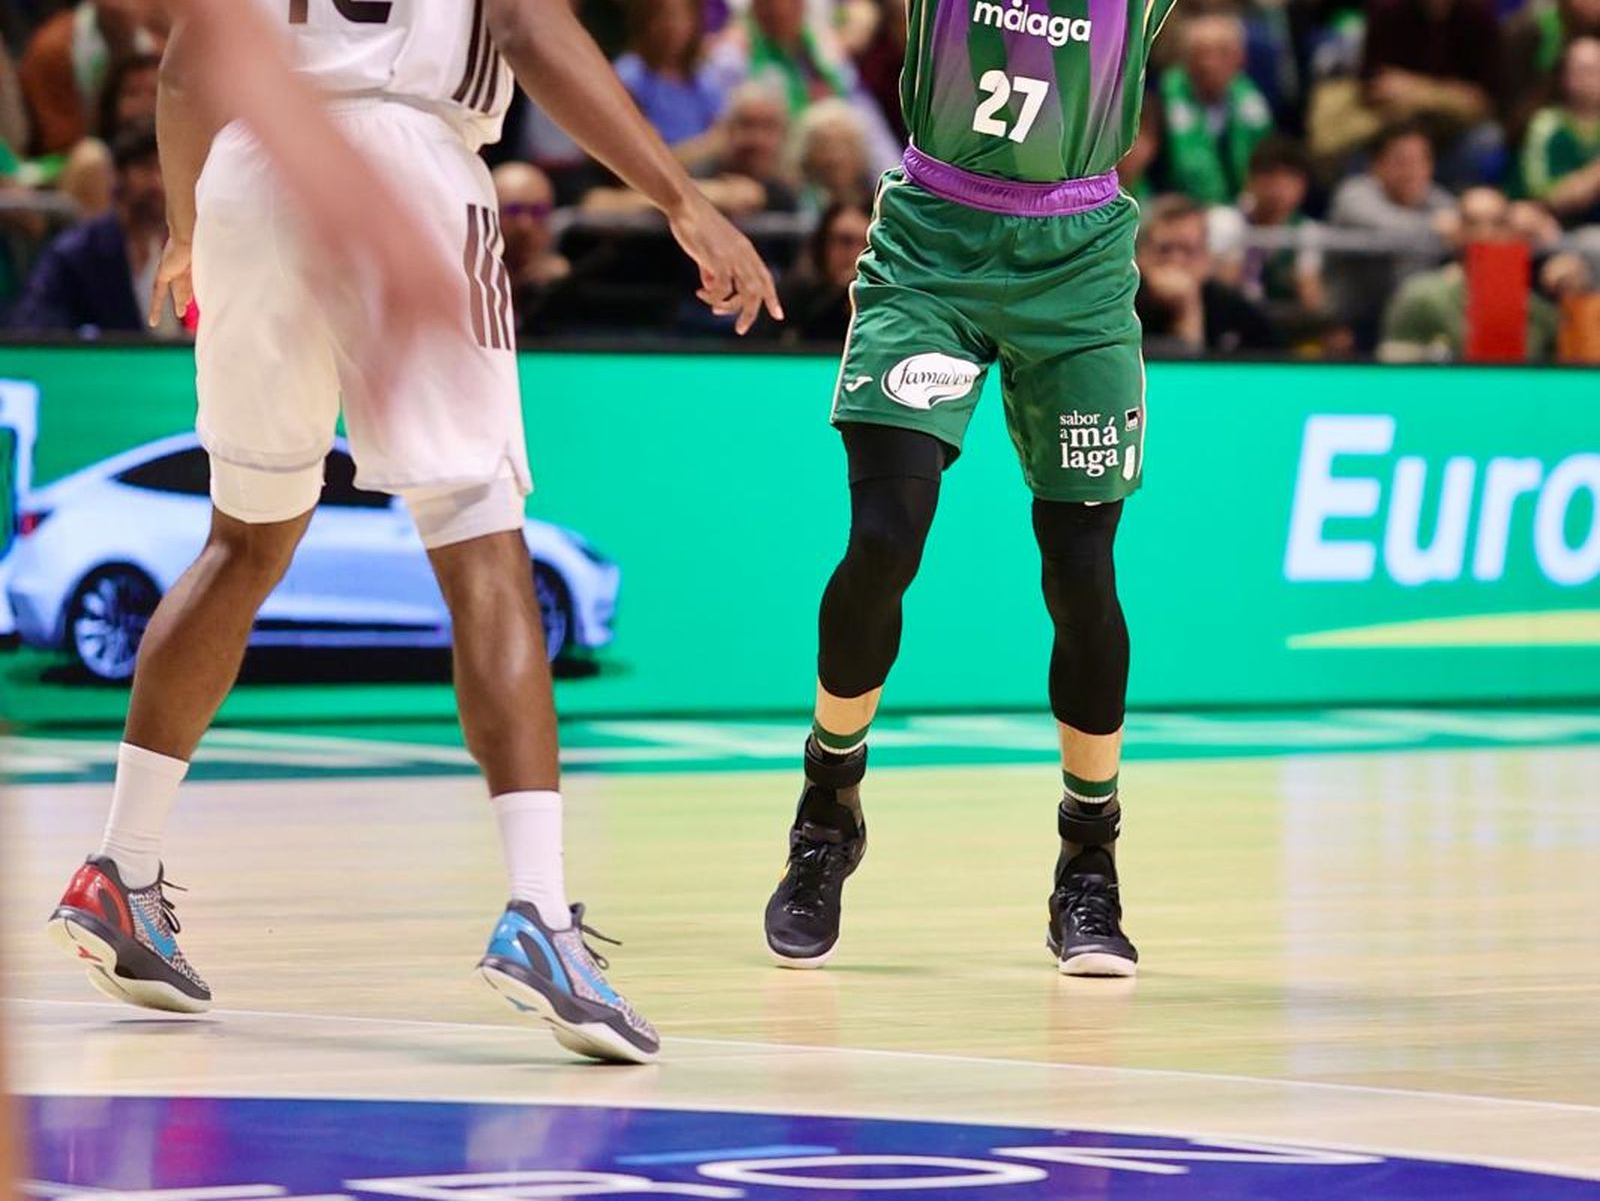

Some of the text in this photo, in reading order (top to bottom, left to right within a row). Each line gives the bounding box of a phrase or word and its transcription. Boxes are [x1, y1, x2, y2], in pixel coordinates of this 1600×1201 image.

[972, 70, 1050, 144] 27
[1060, 410, 1101, 425] sabor
[1060, 428, 1069, 439] a
[1060, 442, 1119, 477] laga
[1283, 413, 1600, 587] Euro
